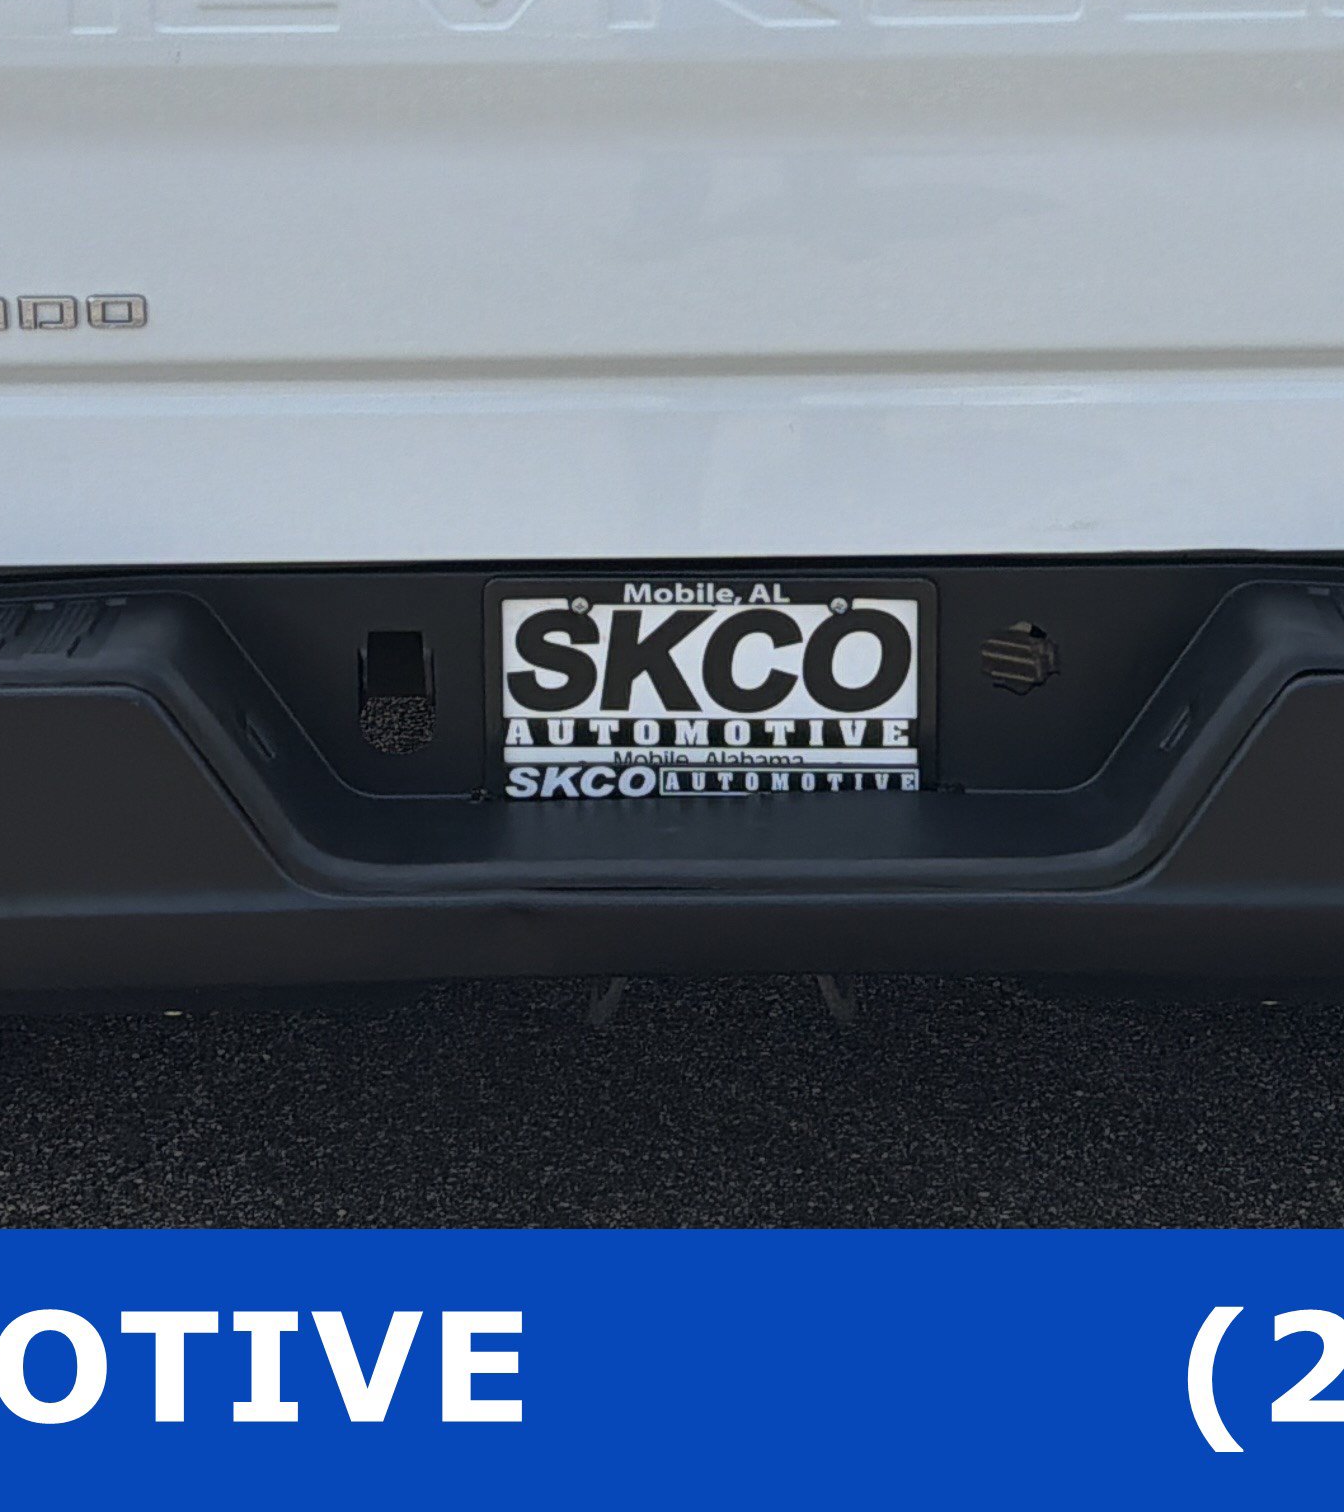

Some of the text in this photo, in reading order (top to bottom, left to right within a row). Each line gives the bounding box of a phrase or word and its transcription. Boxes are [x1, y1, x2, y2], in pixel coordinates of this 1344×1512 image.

[623, 583, 790, 606] Mobile, AL
[506, 607, 913, 713] SKCO
[505, 718, 909, 747] AUTOMOTIVE
[706, 750, 805, 765] Alabama
[506, 766, 916, 798] SKCO AUTOMOTIVE
